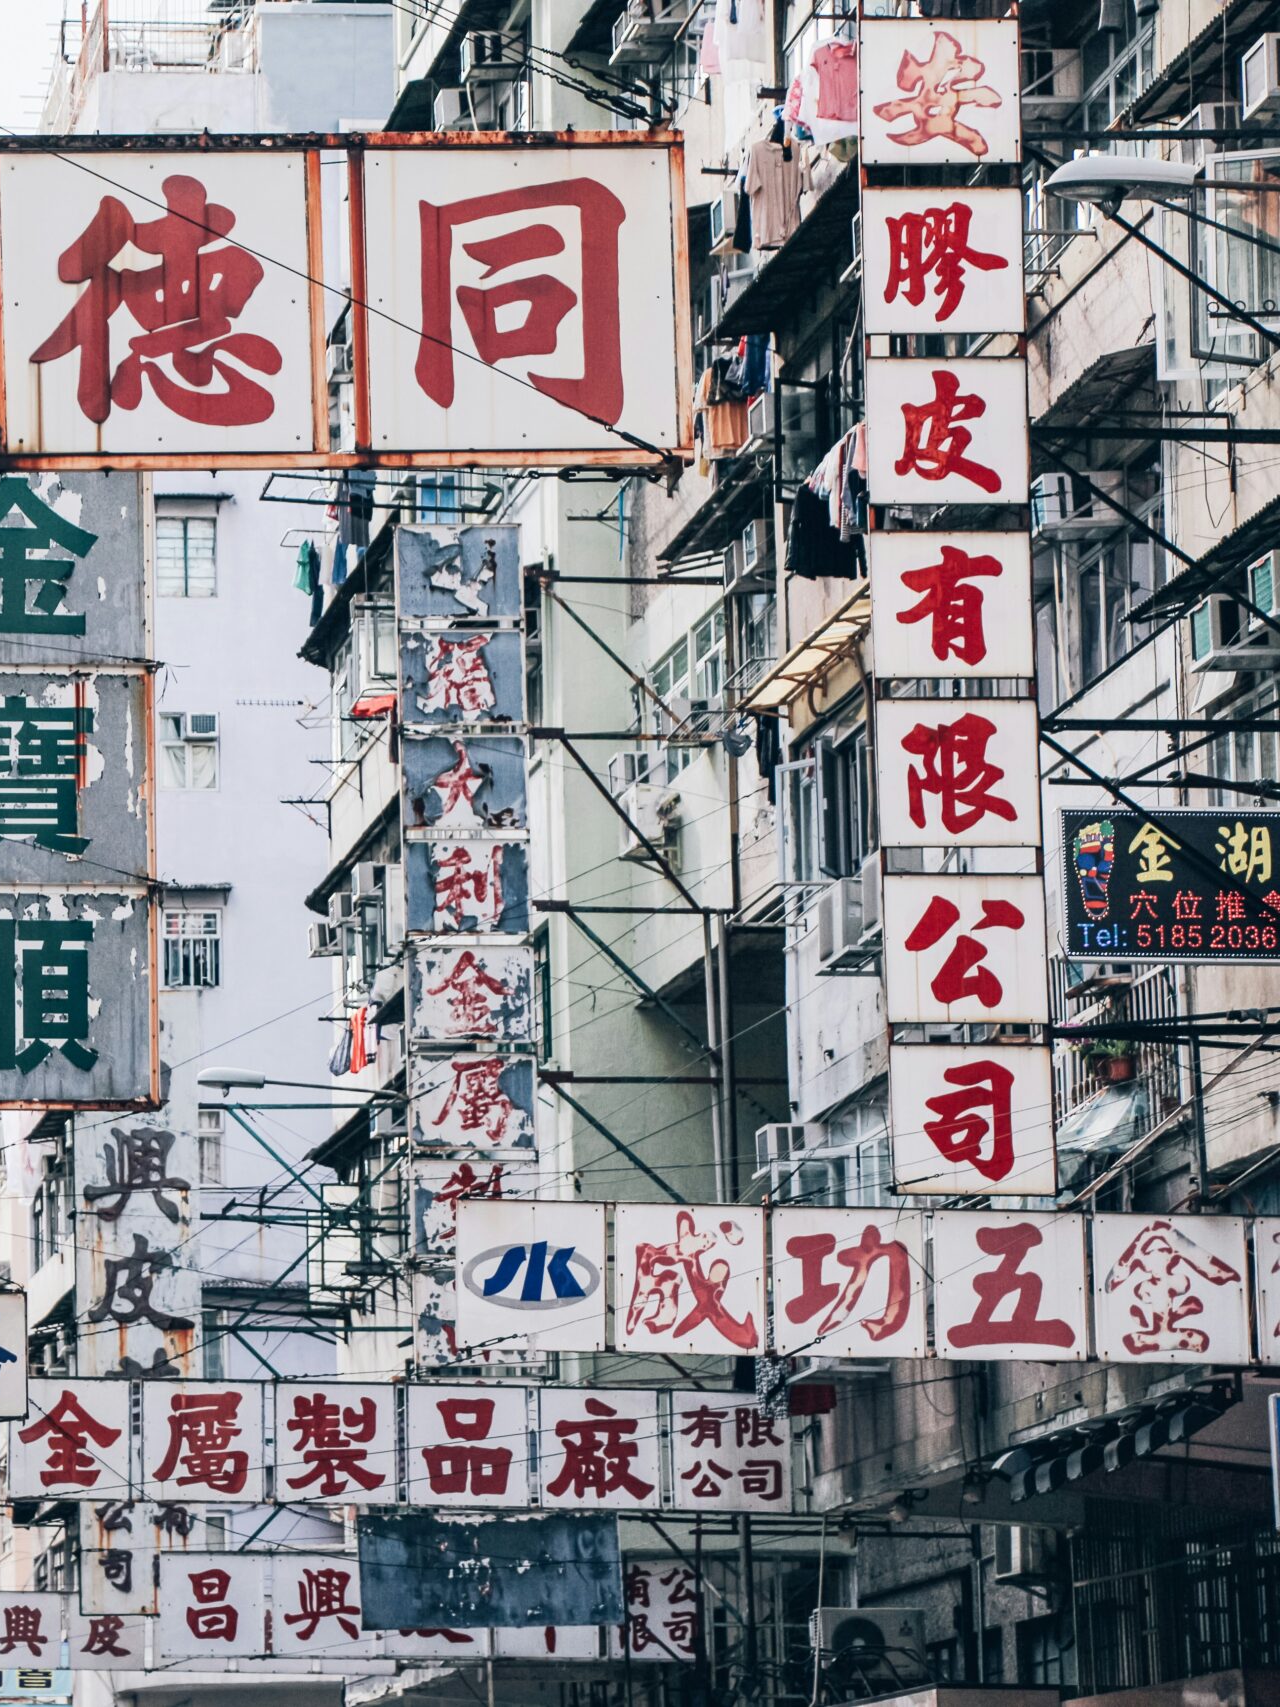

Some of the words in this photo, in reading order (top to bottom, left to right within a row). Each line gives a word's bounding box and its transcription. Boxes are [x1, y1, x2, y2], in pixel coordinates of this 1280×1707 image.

[1128, 821, 1272, 884] 金湖
[1077, 923, 1127, 947] Tel:
[1136, 924, 1203, 948] 5185
[1210, 925, 1277, 949] 2036
[626, 1211, 1280, 1355] 成功五金
[681, 1405, 784, 1449] 有限
[681, 1459, 783, 1500] 公司
